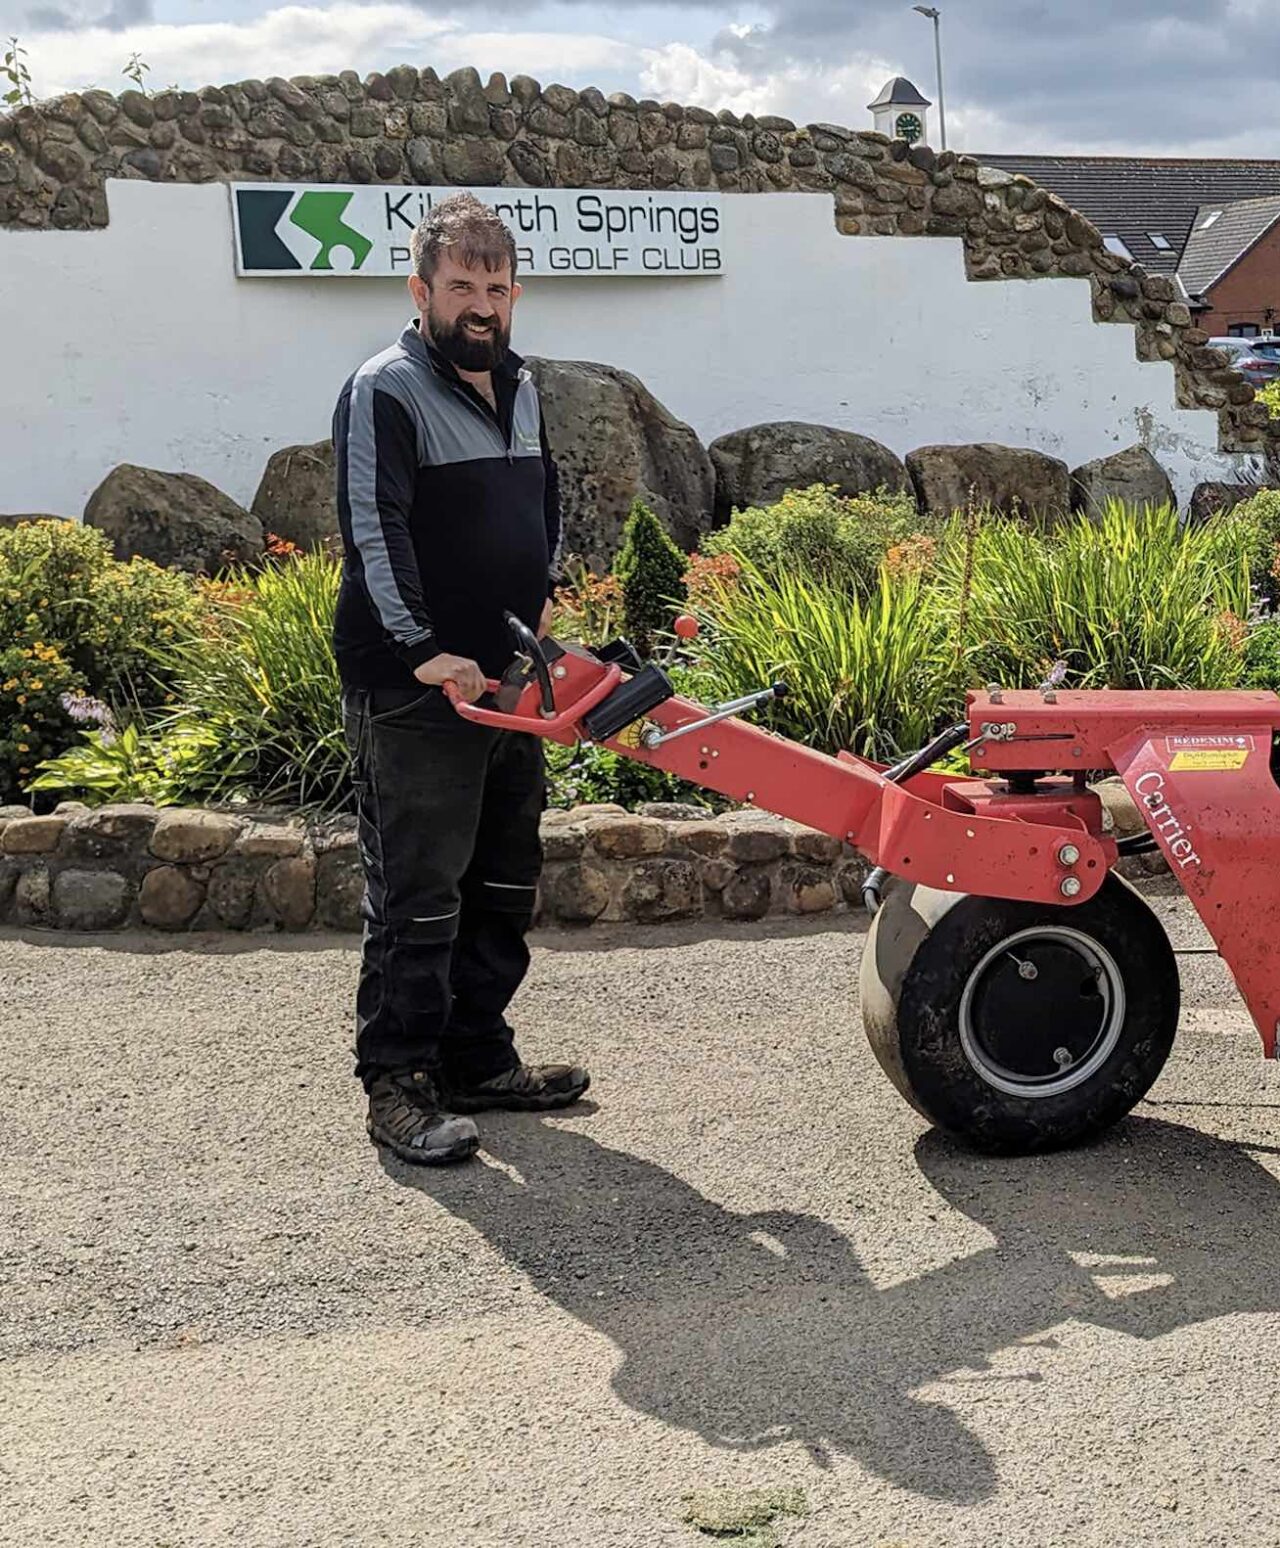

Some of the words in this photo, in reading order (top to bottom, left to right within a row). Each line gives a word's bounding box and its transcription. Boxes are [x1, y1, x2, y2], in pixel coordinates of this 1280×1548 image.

[384, 191, 558, 232] Kirth
[577, 195, 720, 244] Springs
[549, 247, 629, 270] GOLF
[642, 248, 721, 270] CLUB
[1173, 736, 1235, 745] REDEXIM
[1135, 772, 1201, 869] Carrier
